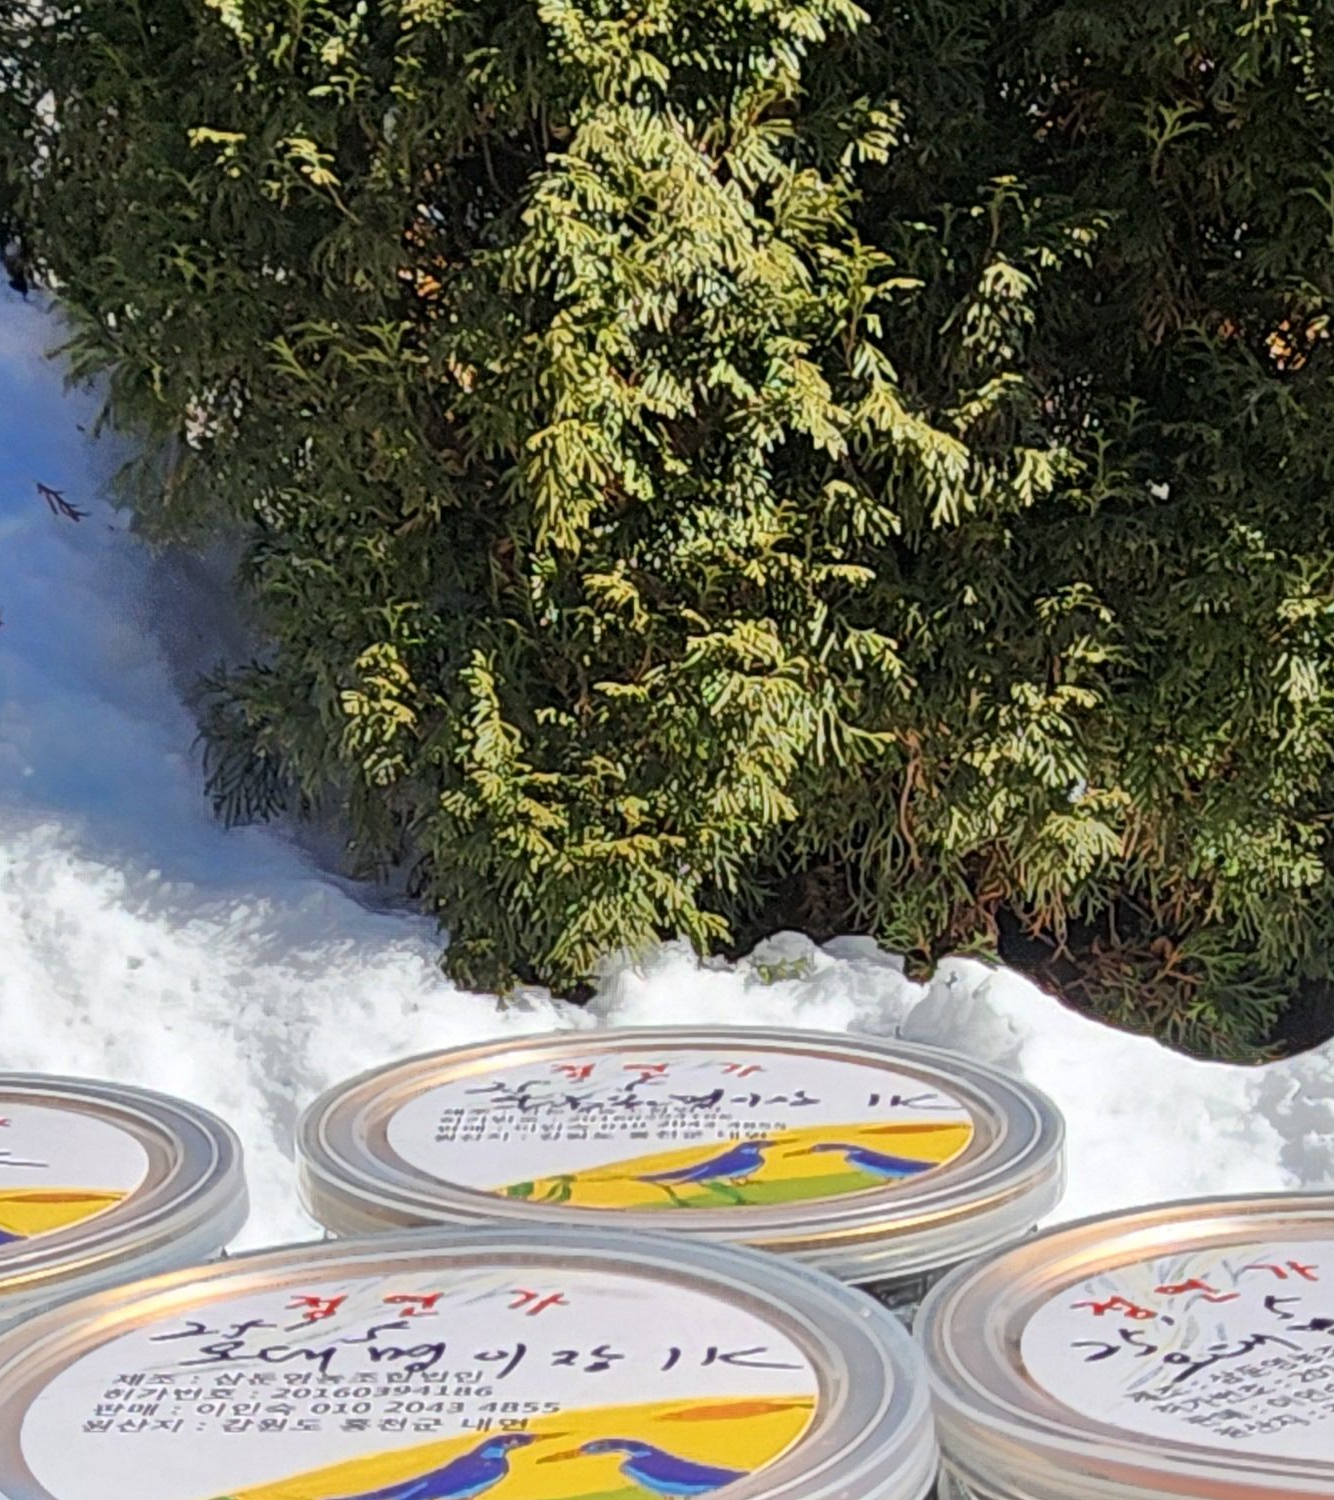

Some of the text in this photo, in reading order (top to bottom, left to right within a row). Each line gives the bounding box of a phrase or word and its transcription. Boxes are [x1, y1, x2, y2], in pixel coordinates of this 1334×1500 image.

[309, 1401, 373, 1415] 010
[383, 1401, 466, 1414] 2043
[476, 1401, 562, 1414] 4855
